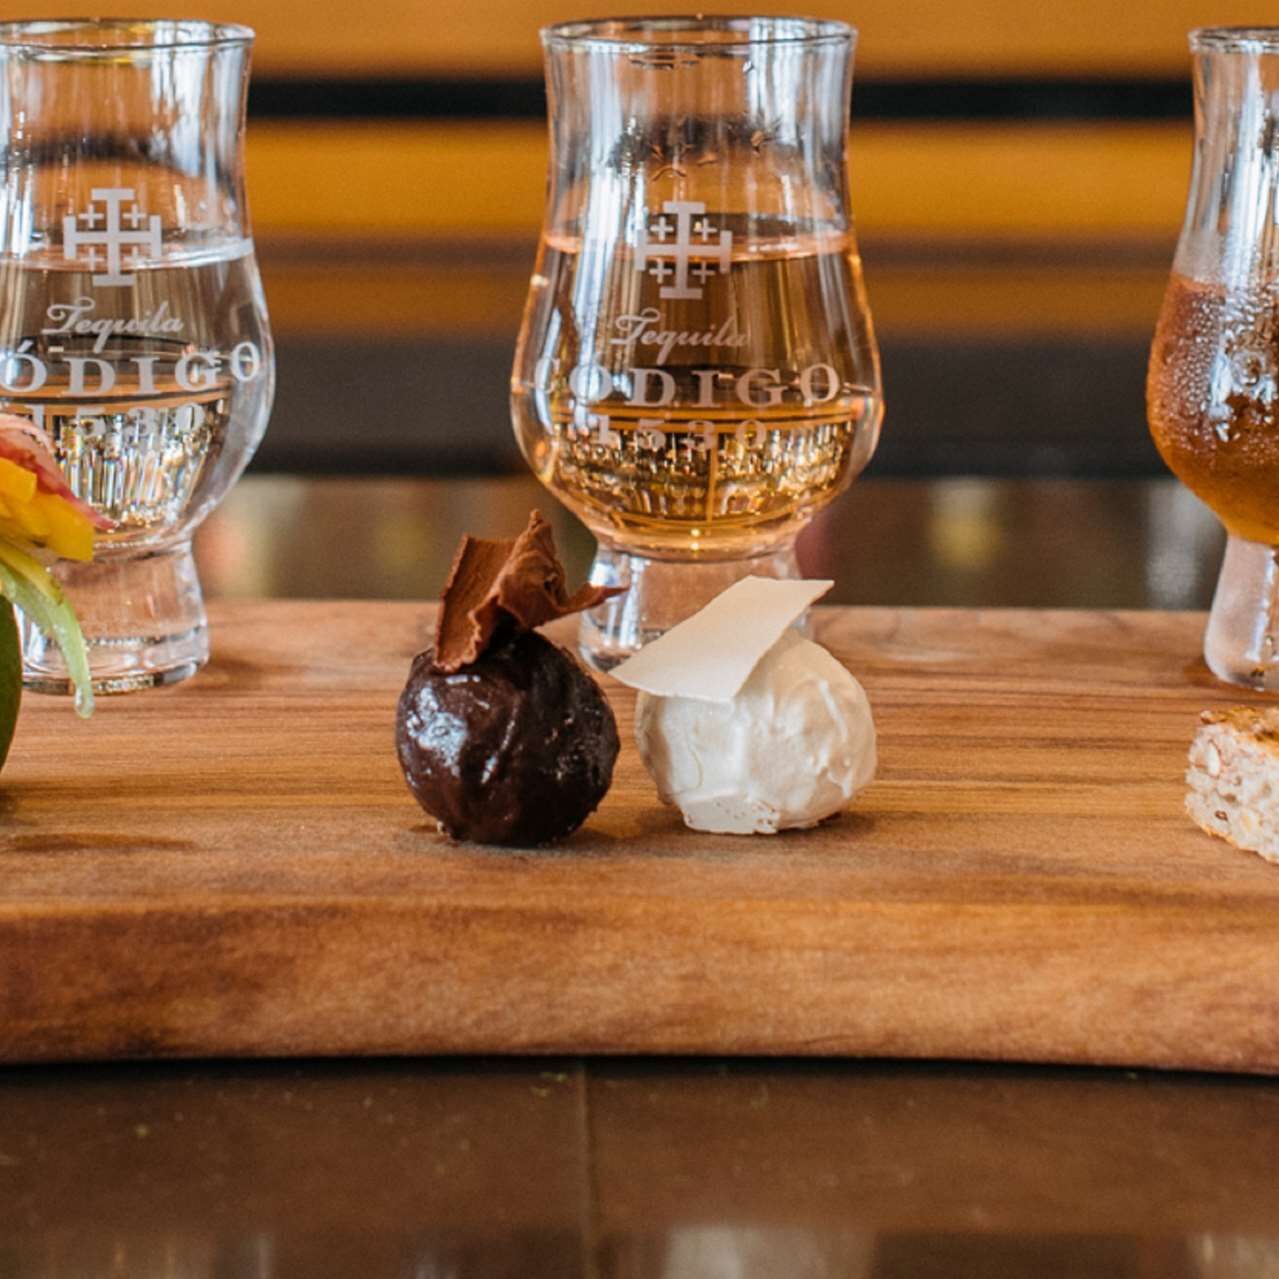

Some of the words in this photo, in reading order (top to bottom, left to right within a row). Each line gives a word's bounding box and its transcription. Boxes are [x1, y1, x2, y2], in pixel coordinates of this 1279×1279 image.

[41, 296, 185, 353] Tequila
[609, 307, 749, 365] Tequila
[590, 414, 767, 452] 1530
